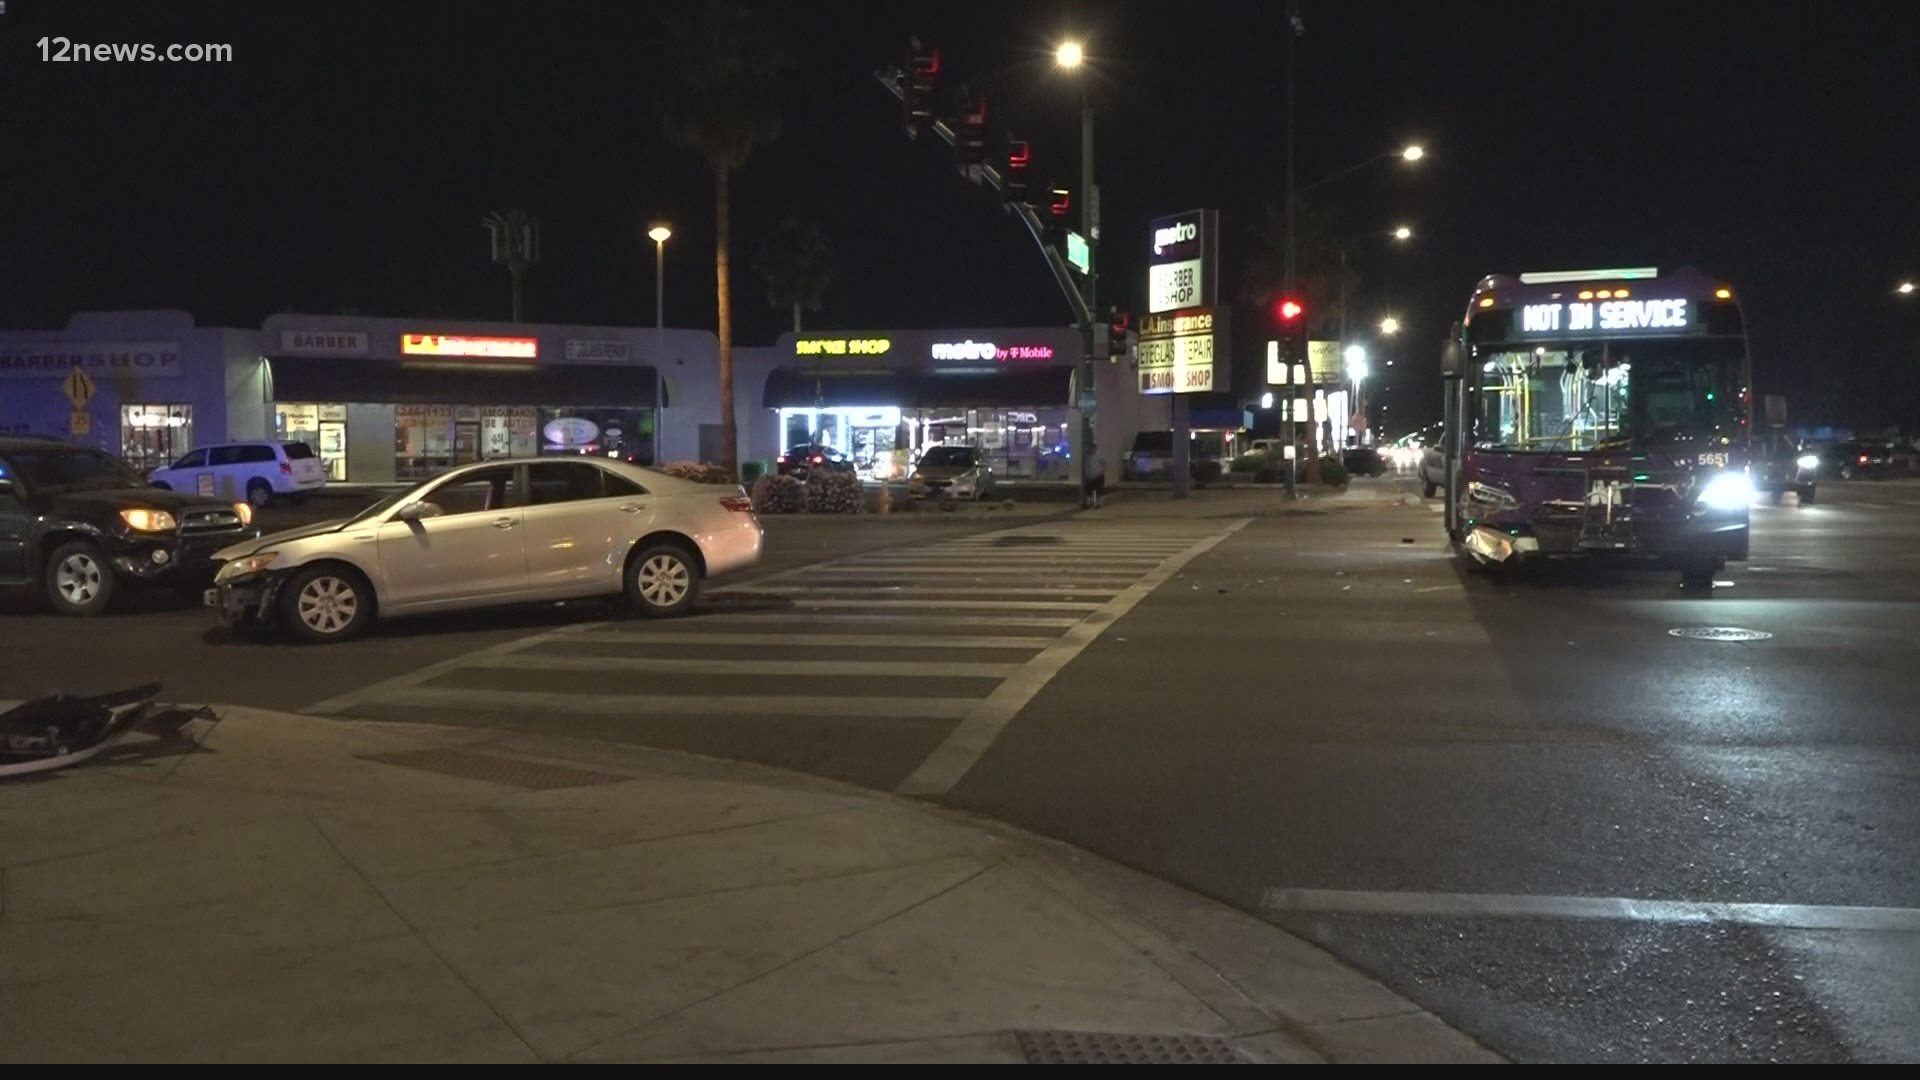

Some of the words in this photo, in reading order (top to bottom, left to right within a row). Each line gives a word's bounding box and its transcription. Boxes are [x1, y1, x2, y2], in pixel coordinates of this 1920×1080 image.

[1154, 222, 1197, 247] tro
[1524, 304, 1562, 331] NOT
[1569, 303, 1593, 330] IN
[1600, 299, 1687, 329] SERVICE
[294, 336, 358, 348] BARBER
[848, 340, 890, 354] SHOP
[932, 340, 996, 359] metro
[996, 347, 1009, 360] by
[1141, 342, 1180, 365] EYEGLAS
[1184, 338, 1212, 361] EPAIR
[1151, 372, 1182, 389] SMO
[1186, 369, 1211, 387] SHOP
[485, 418, 497, 429] DE
[1698, 453, 1729, 466] 5651
